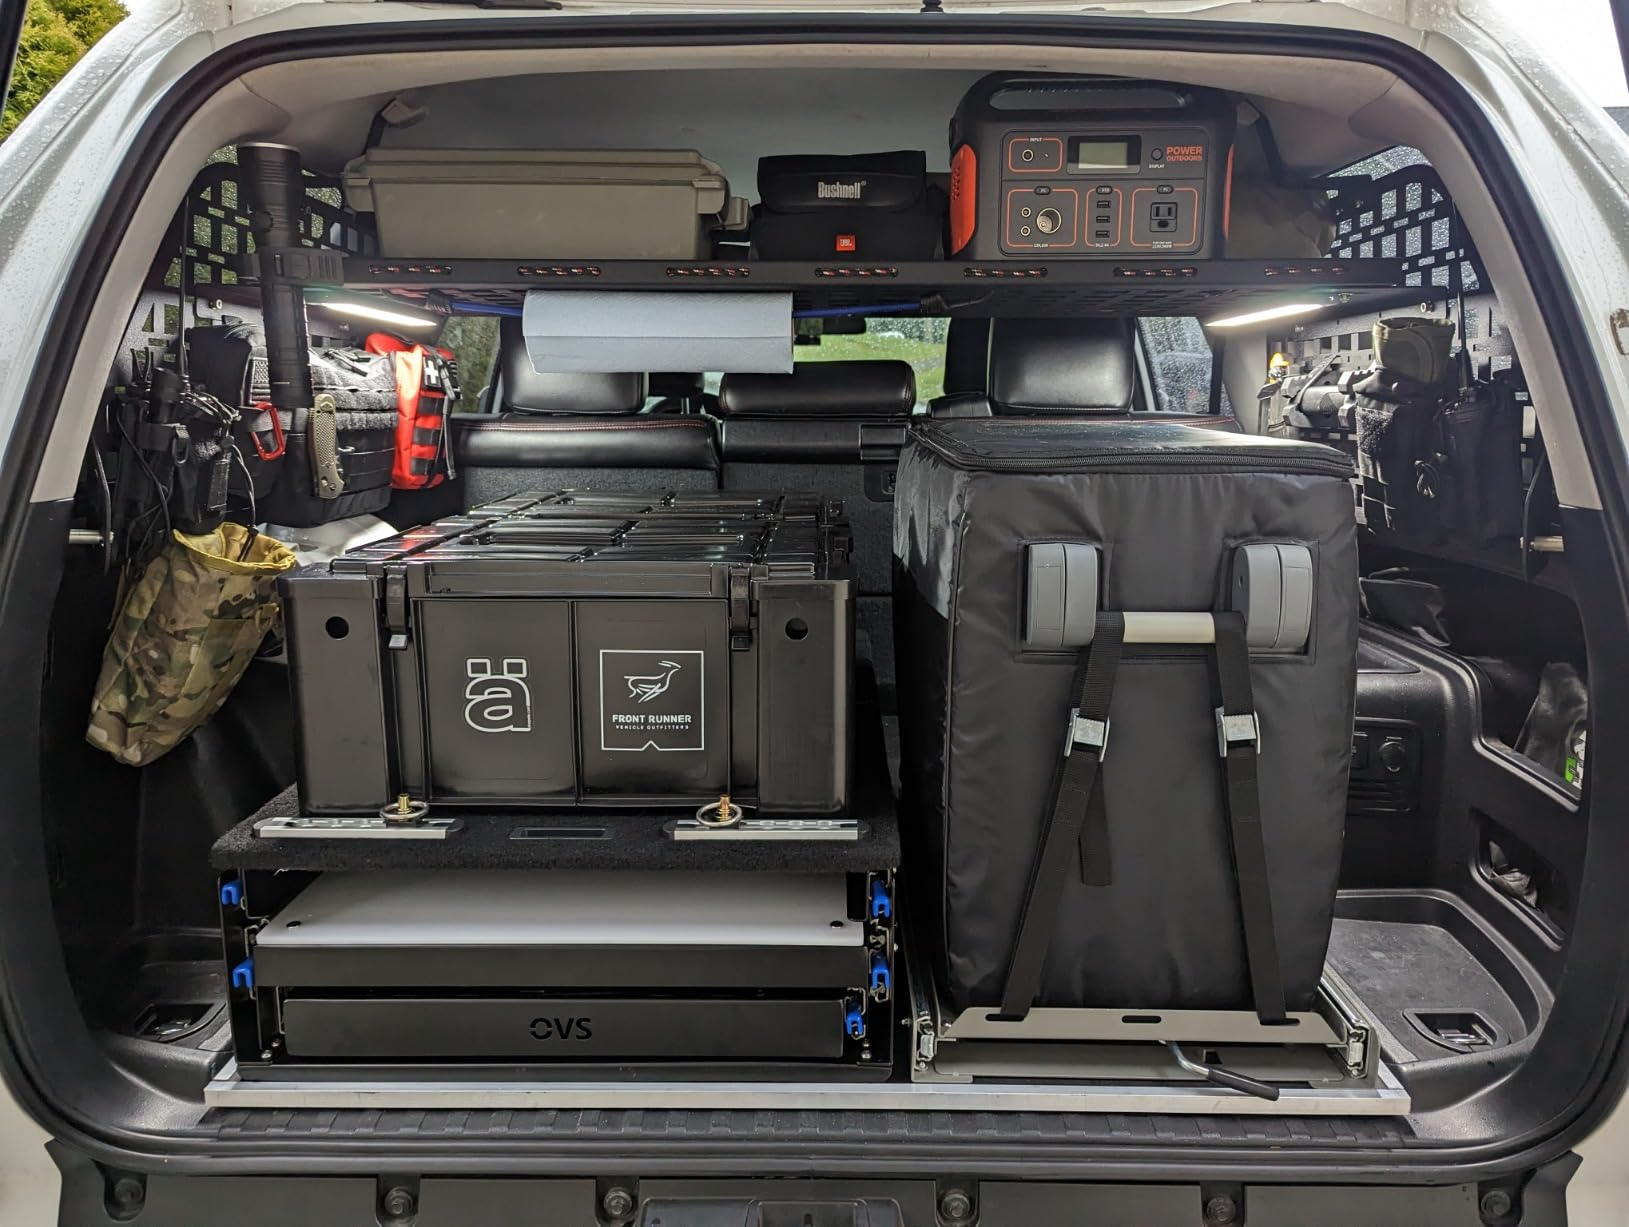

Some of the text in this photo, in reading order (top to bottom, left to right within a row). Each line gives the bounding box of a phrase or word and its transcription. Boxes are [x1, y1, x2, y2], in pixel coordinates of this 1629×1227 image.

[1166, 146, 1203, 155] POWER
[818, 181, 862, 199] Bushnell
[612, 714, 692, 724] FRONT RUNNER
[529, 1018, 592, 1040] OVS
